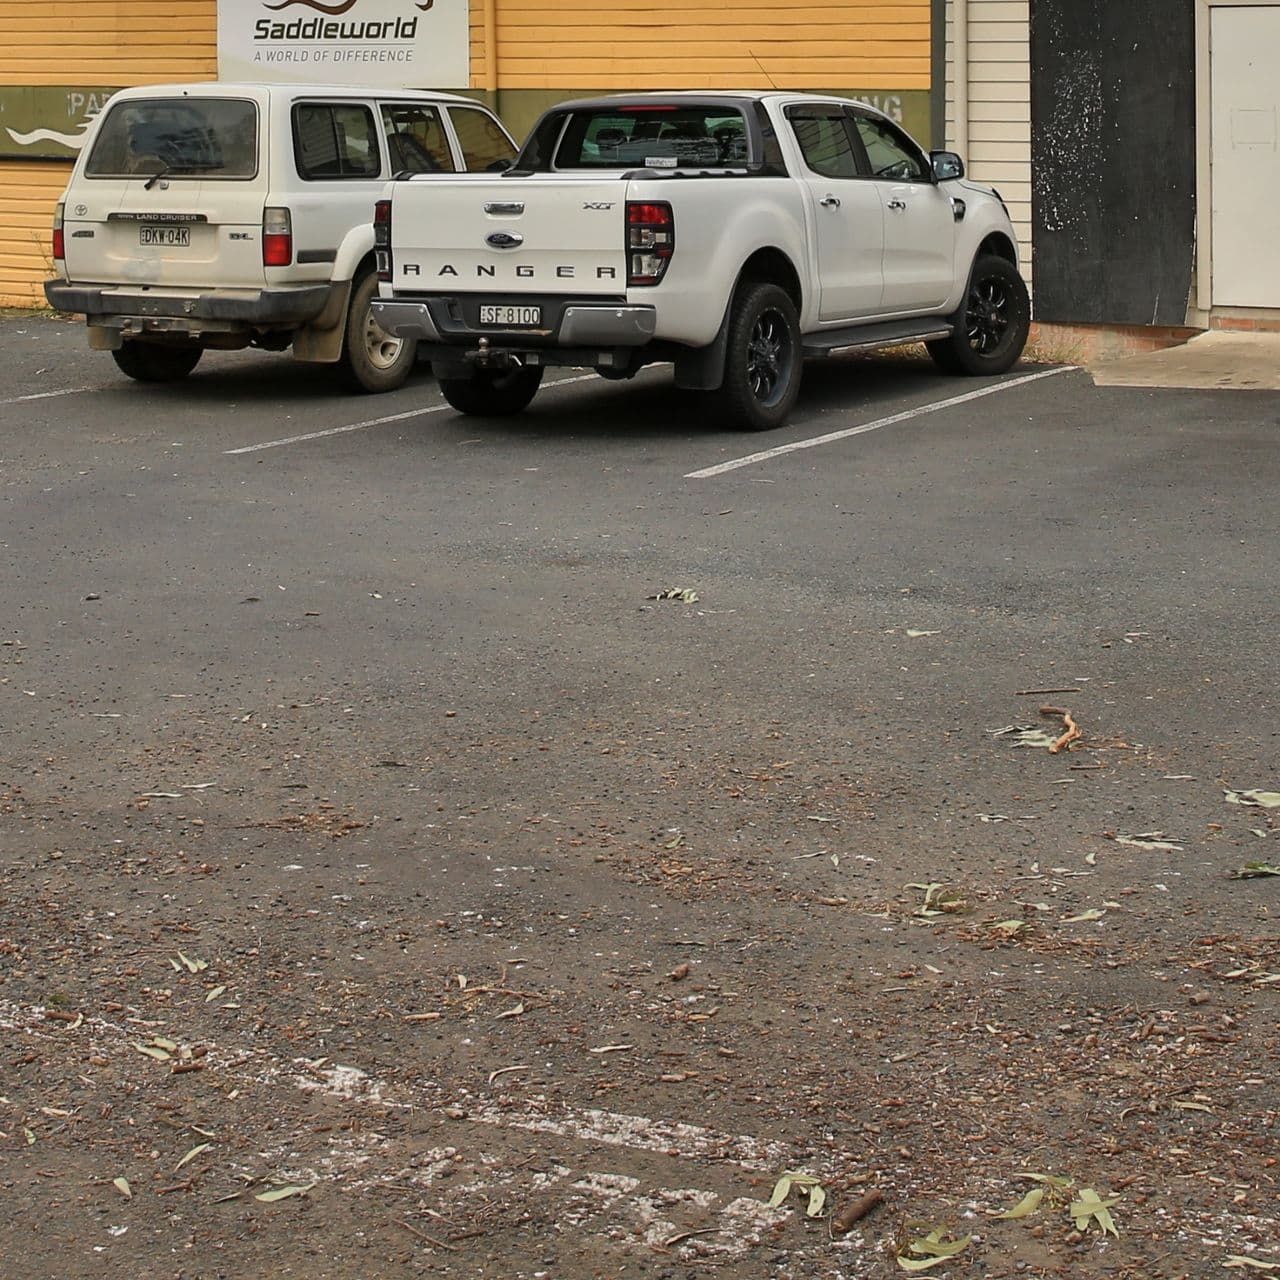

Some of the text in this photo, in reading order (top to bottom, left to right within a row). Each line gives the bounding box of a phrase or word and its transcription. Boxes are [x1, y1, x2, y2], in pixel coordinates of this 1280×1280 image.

[253, 17, 418, 40] Saddleworld
[253, 49, 414, 62] A WORLD OF DIFFERENCE
[403, 264, 616, 279] RANGER
